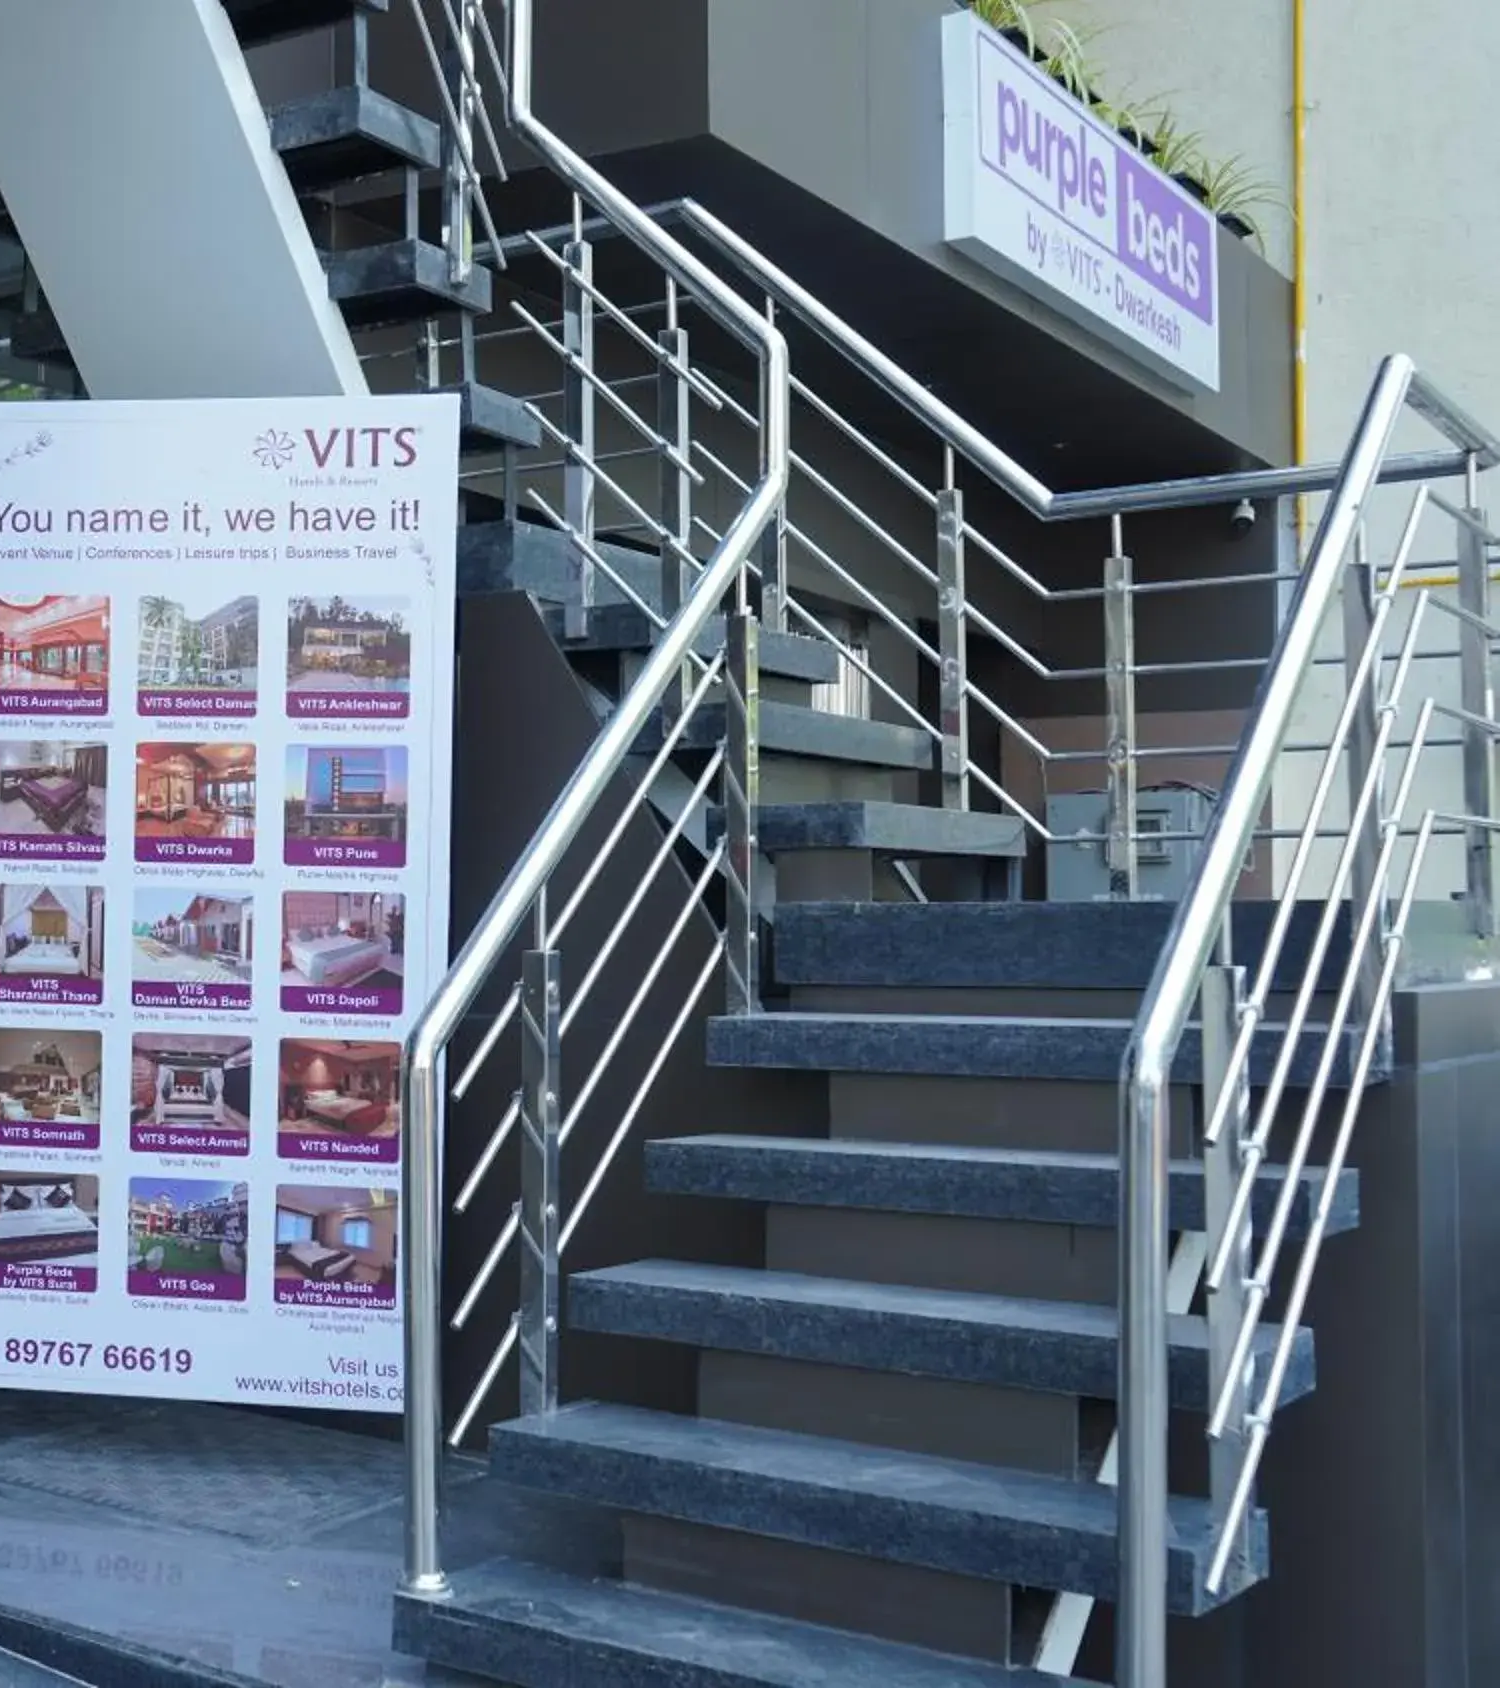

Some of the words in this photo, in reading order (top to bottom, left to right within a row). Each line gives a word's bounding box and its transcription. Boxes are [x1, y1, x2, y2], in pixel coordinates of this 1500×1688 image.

[997, 80, 1107, 218] purple
[1126, 172, 1200, 299] beds
[1027, 210, 1047, 269] by
[1066, 239, 1100, 295] VITS
[1115, 273, 1181, 352] Dwarkesh
[304, 427, 417, 468] VITS
[67, 508, 169, 533] name
[183, 501, 211, 537] it,
[224, 508, 275, 532] we
[290, 501, 376, 531] have
[391, 500, 420, 531] it!
[32, 548, 73, 560] Venue
[85, 547, 173, 560] Conferences
[185, 547, 235, 560] Leisure
[240, 547, 269, 561] trips
[286, 546, 350, 560] Business
[355, 546, 397, 560] Travel
[1, 696, 28, 707] VITS
[31, 696, 103, 710] Aurangabad
[143, 697, 172, 708] VITS
[175, 697, 212, 709] Select
[299, 698, 327, 709] VITS
[329, 698, 402, 710] Ankleshwar
[19, 841, 64, 853] Kamats
[155, 843, 185, 855] VITS
[187, 843, 233, 856] Dwarka
[314, 847, 342, 858] VITS
[346, 847, 378, 859] Pune
[30, 979, 59, 990] VITS
[176, 983, 205, 995] VITS
[0, 988, 59, 1001] Sharanam
[61, 990, 99, 1003] Thane
[135, 993, 177, 1005] Daman
[179, 995, 217, 1007] Devka
[307, 993, 335, 1005] VITS
[339, 994, 380, 1008] Dapoli
[2, 1127, 29, 1138] VITS
[32, 1128, 85, 1141] Somnath
[137, 1132, 166, 1144] VITS
[169, 1133, 207, 1146] Select
[300, 1139, 329, 1152] VITS
[331, 1142, 380, 1155] Nanded
[7, 1264, 42, 1277] Purple
[45, 1265, 73, 1277] Beds
[3, 1277, 16, 1289] by
[19, 1278, 45, 1288] VITS
[48, 1279, 77, 1290] Surat
[159, 1279, 187, 1290] VITS
[190, 1280, 215, 1292] Goa
[303, 1279, 341, 1293] Purple
[344, 1280, 373, 1293] Beds
[279, 1292, 294, 1303] by
[296, 1292, 324, 1304] VITS
[326, 1293, 395, 1308] Aurangabad
[5, 1338, 93, 1367] 89767
[103, 1345, 192, 1373] 66619
[327, 1356, 368, 1376] Visit
[375, 1362, 398, 1377] us
